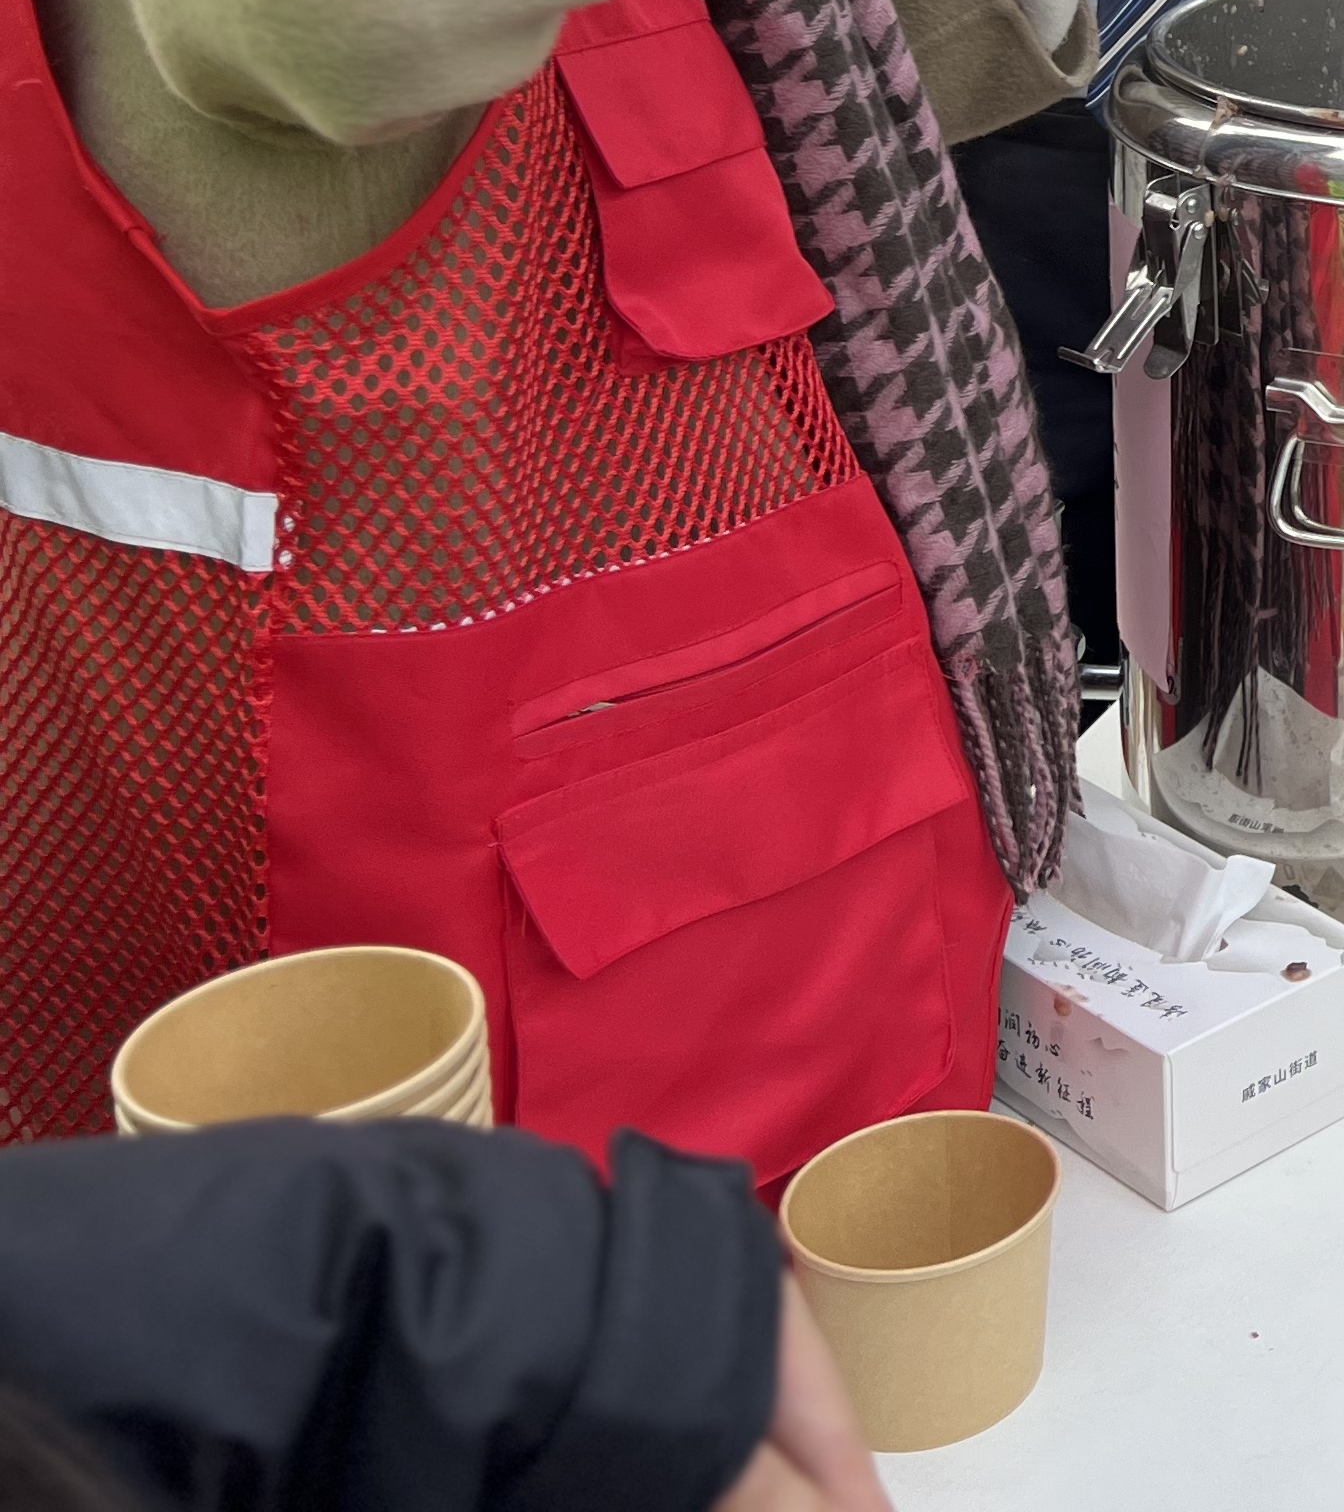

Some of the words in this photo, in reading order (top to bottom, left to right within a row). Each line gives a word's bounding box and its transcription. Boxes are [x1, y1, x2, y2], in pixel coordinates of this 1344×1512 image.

[998, 1007, 1061, 1057] 润初心
[1241, 1050, 1320, 1104] 戚家山街道
